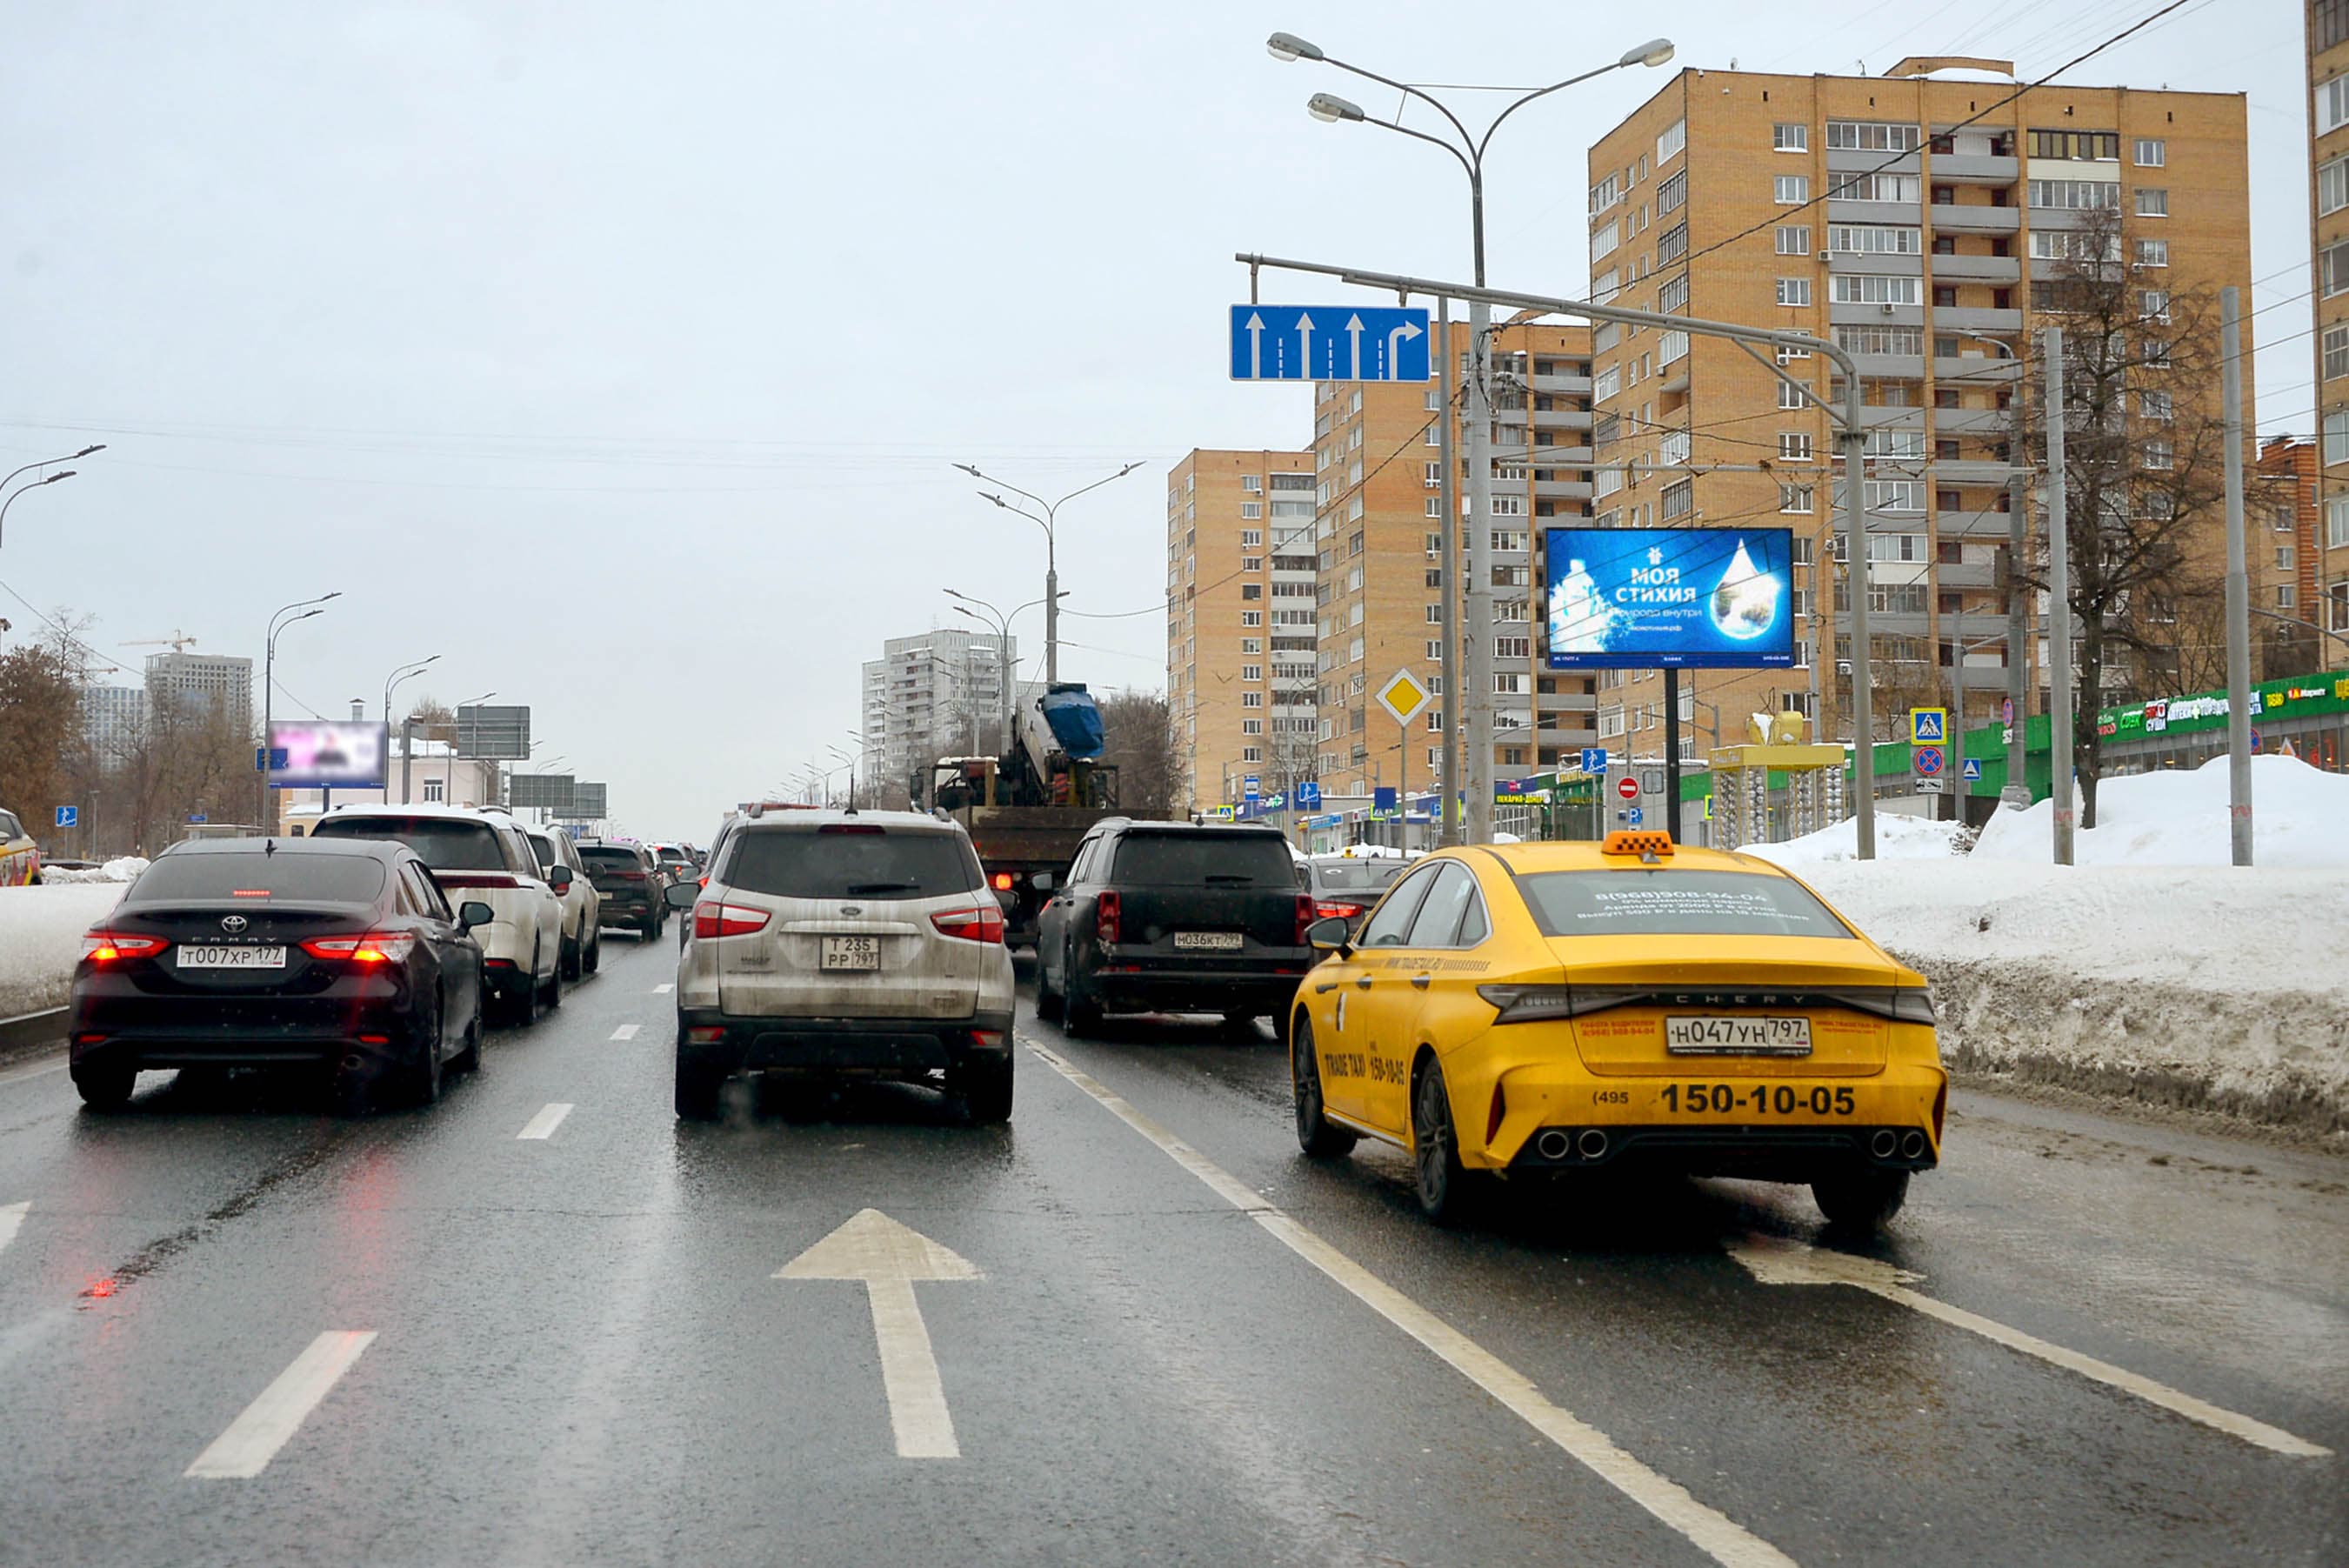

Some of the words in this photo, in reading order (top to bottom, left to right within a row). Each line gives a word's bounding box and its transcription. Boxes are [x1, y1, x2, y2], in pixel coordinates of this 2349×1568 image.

[1631, 568, 1679, 584] МОЯ
[1616, 587, 1696, 603] СТИХИЯ
[1662, 610, 1703, 618] внутри
[845, 938, 871, 951] 235
[256, 947, 280, 960] 177
[829, 954, 849, 966] РР
[855, 953, 874, 964] 797
[1676, 995, 1805, 1004] CHERY
[1676, 1021, 1766, 1043] Н047УН
[1769, 1020, 1803, 1038] 797
[1325, 1053, 1348, 1077] TRADE
[1349, 1053, 1365, 1078] TAXI
[1661, 1084, 1855, 1115] 150-10-05
